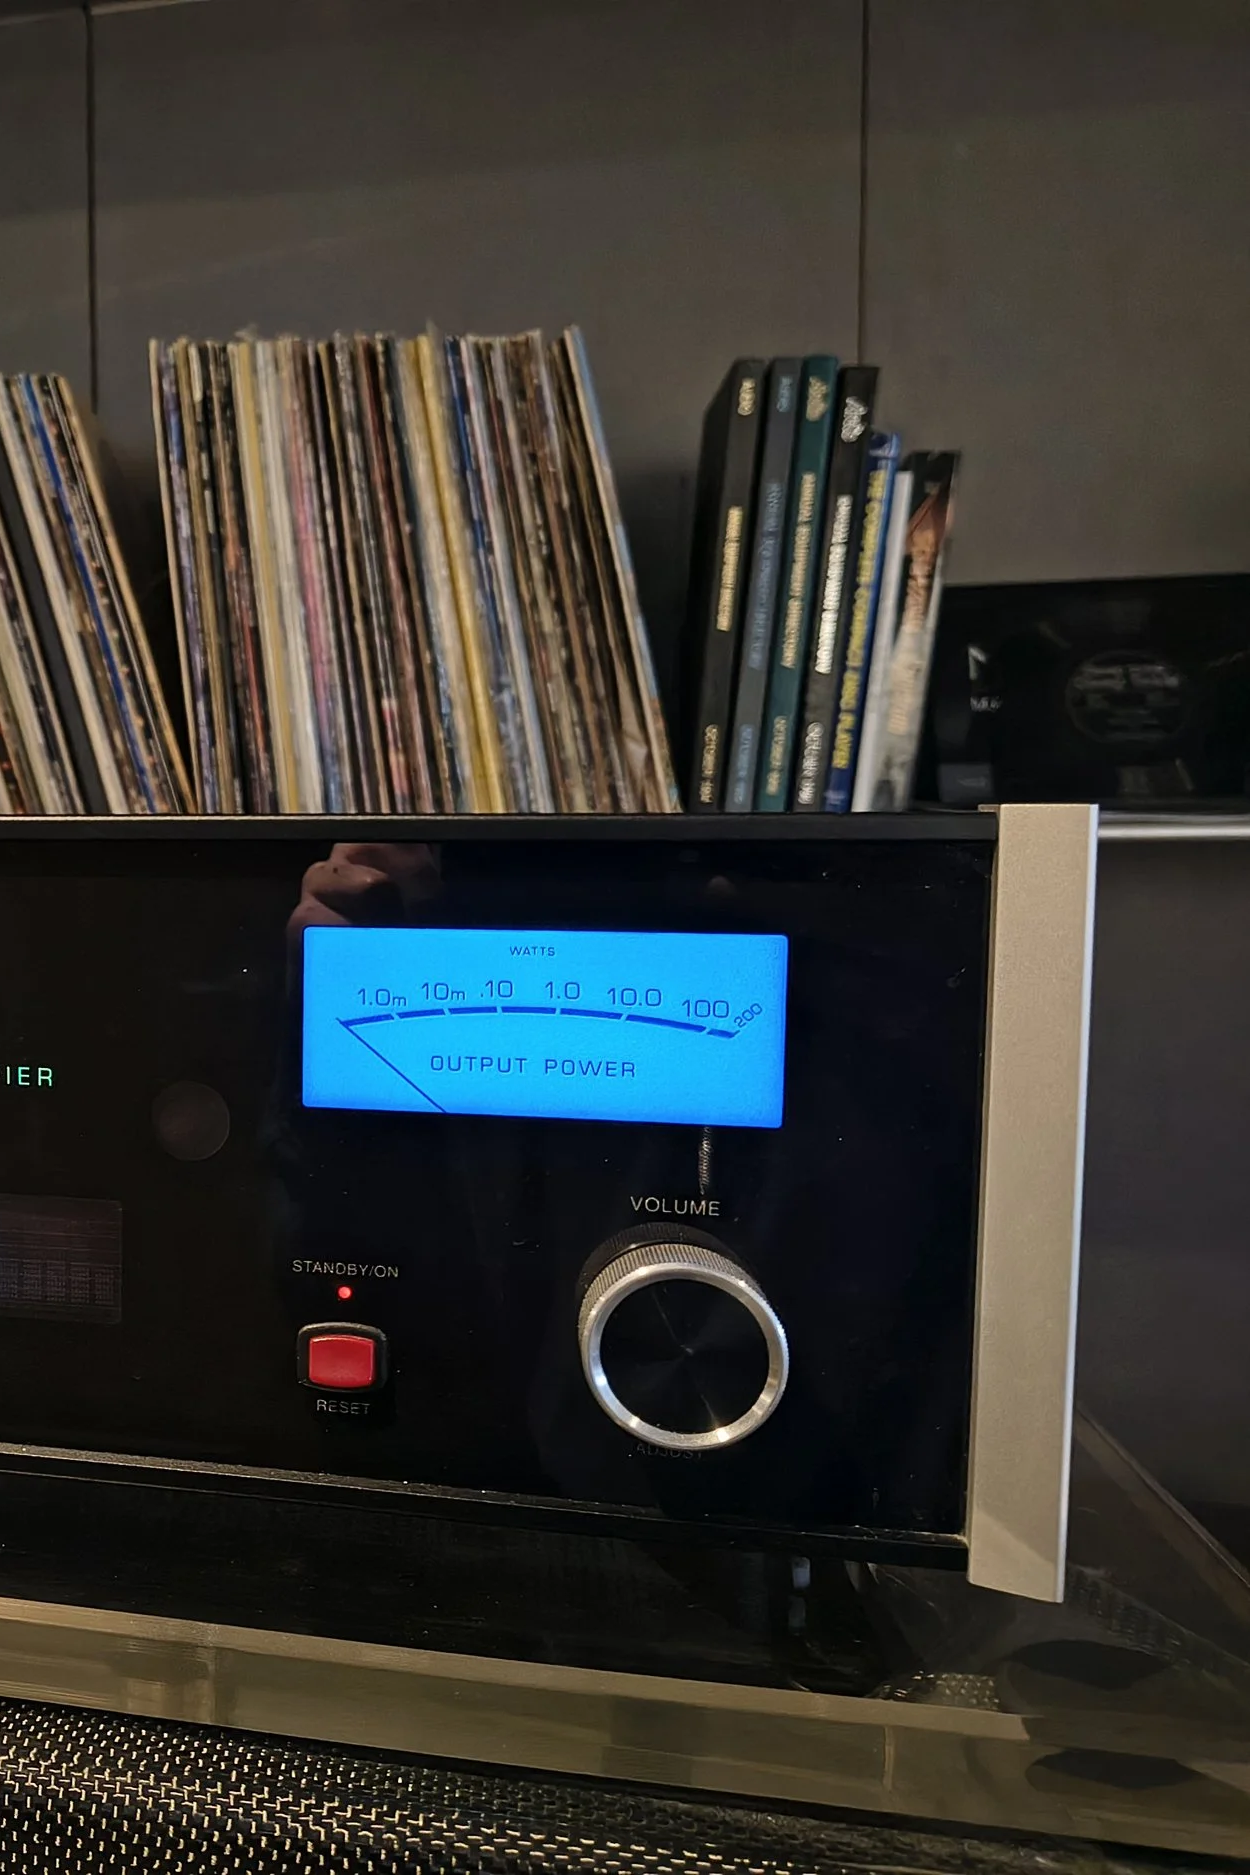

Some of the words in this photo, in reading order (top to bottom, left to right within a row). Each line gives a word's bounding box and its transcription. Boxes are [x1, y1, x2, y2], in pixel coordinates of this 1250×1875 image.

[509, 946, 556, 957] WATTS
[356, 987, 407, 1008] 1.0m
[420, 982, 466, 1002] 10m
[479, 979, 514, 998] .10
[544, 981, 581, 1000] 1.0
[606, 987, 662, 1008] 10.0
[681, 999, 730, 1019] 100
[733, 1002, 764, 1030] 200
[430, 1055, 528, 1075] OUTPUT
[544, 1058, 637, 1078] POWER
[629, 1196, 721, 1217] VOLUME
[291, 1259, 399, 1279] STANDBY/ON
[316, 1399, 370, 1415] RESET
